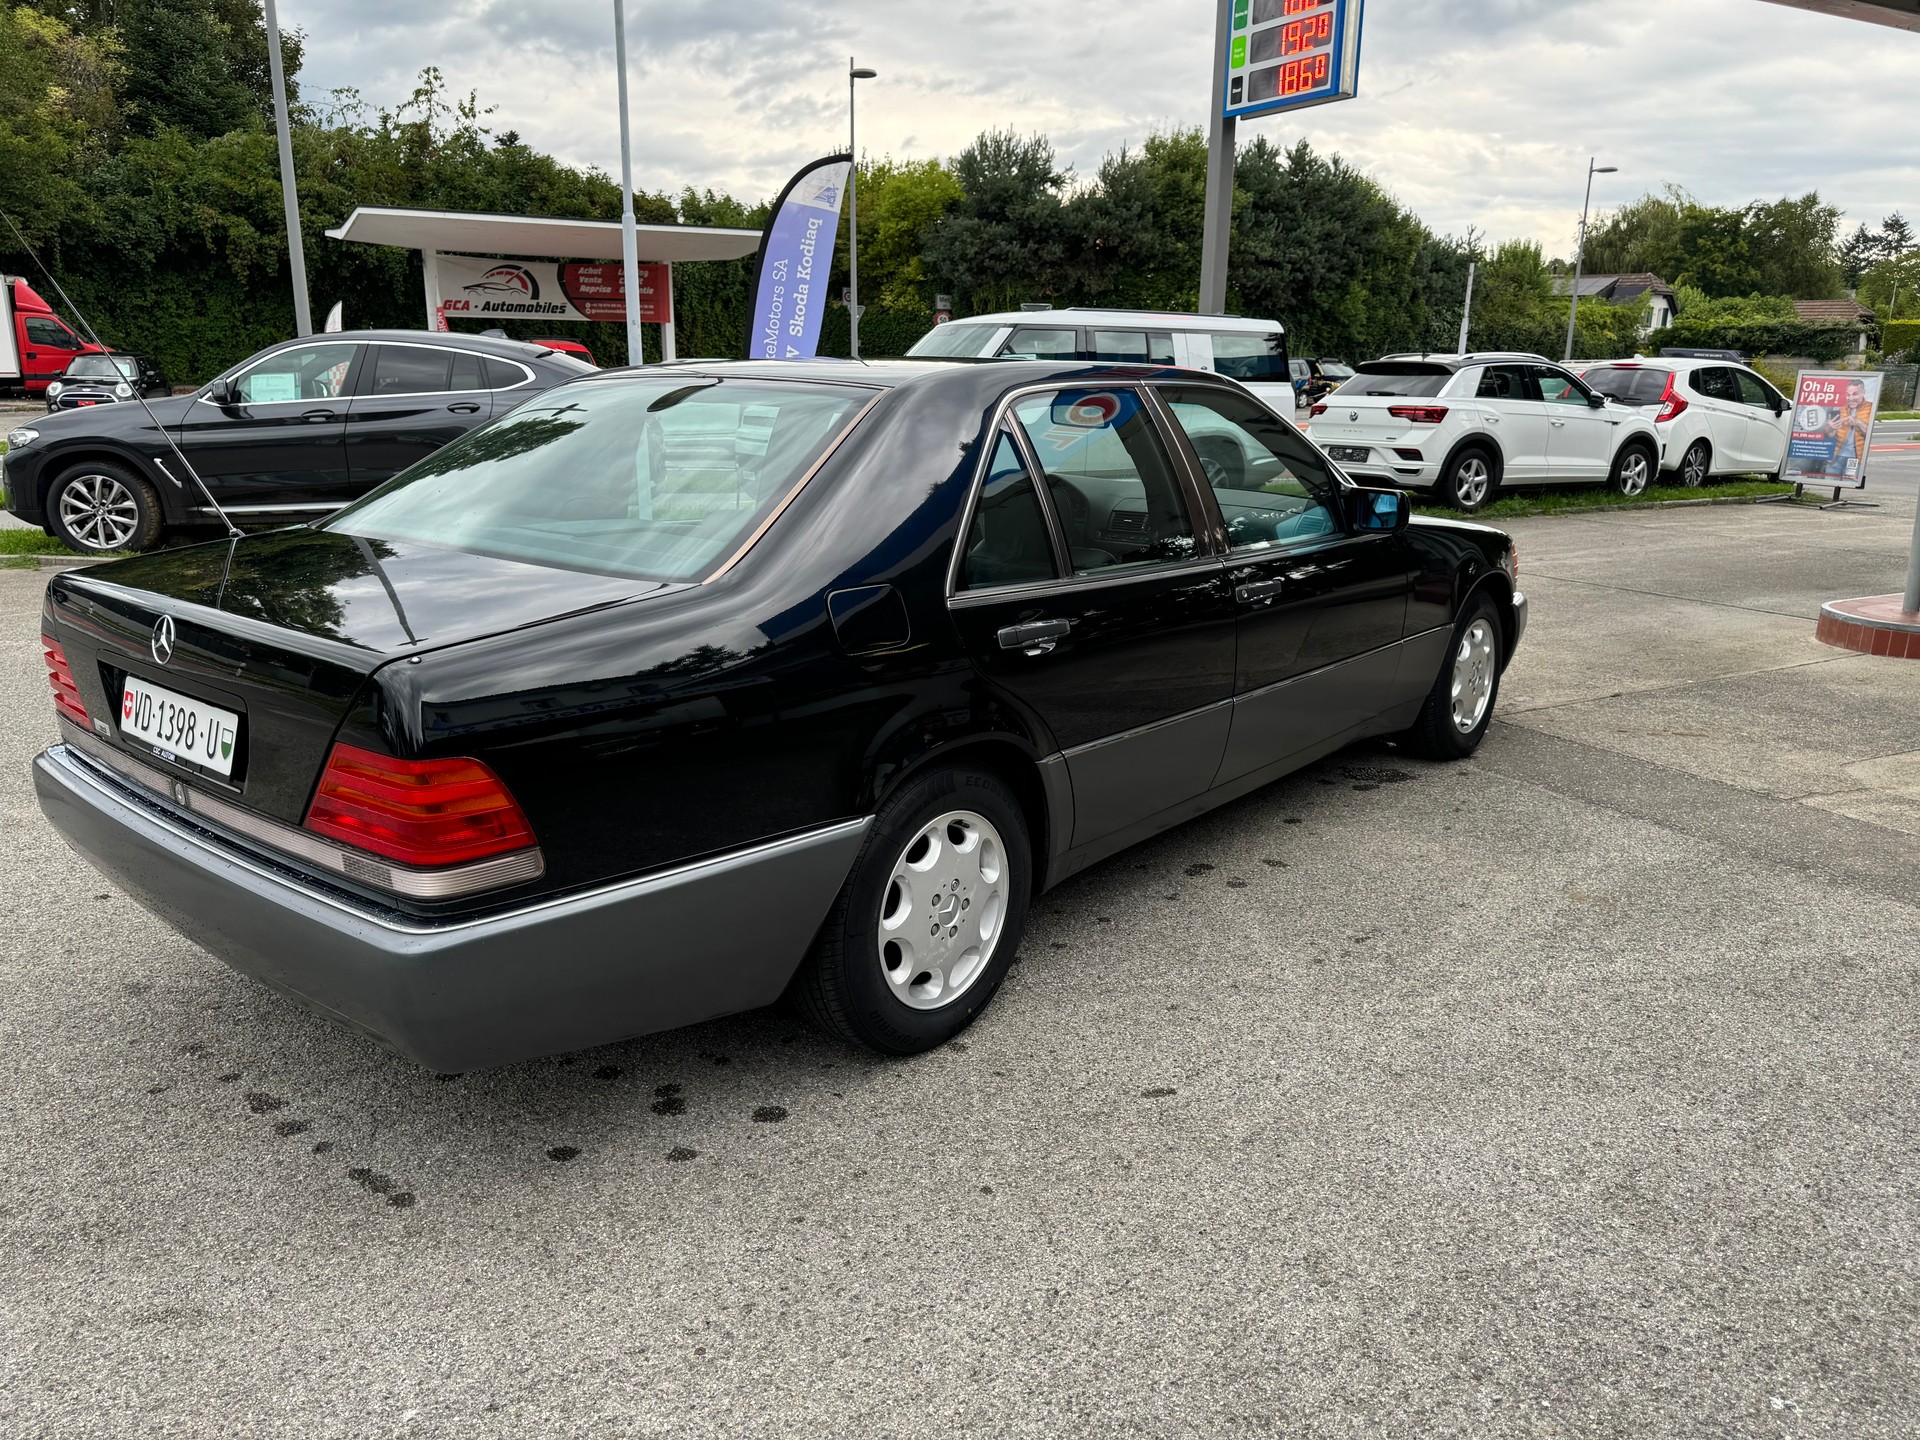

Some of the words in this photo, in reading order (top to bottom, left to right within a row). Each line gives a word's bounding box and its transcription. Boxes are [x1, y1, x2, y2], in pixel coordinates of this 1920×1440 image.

[796, 217, 823, 281] Kodiaq
[578, 267, 602, 275] Achat
[772, 258, 789, 282] SA
[580, 285, 612, 294] Reprise
[443, 299, 470, 311] GCA
[481, 301, 567, 314] Automobiles
[789, 284, 809, 337] Skoda
[1803, 380, 1821, 391] Oh
[1823, 382, 1835, 392] la
[869, 1009, 921, 1046] SUPERIA
